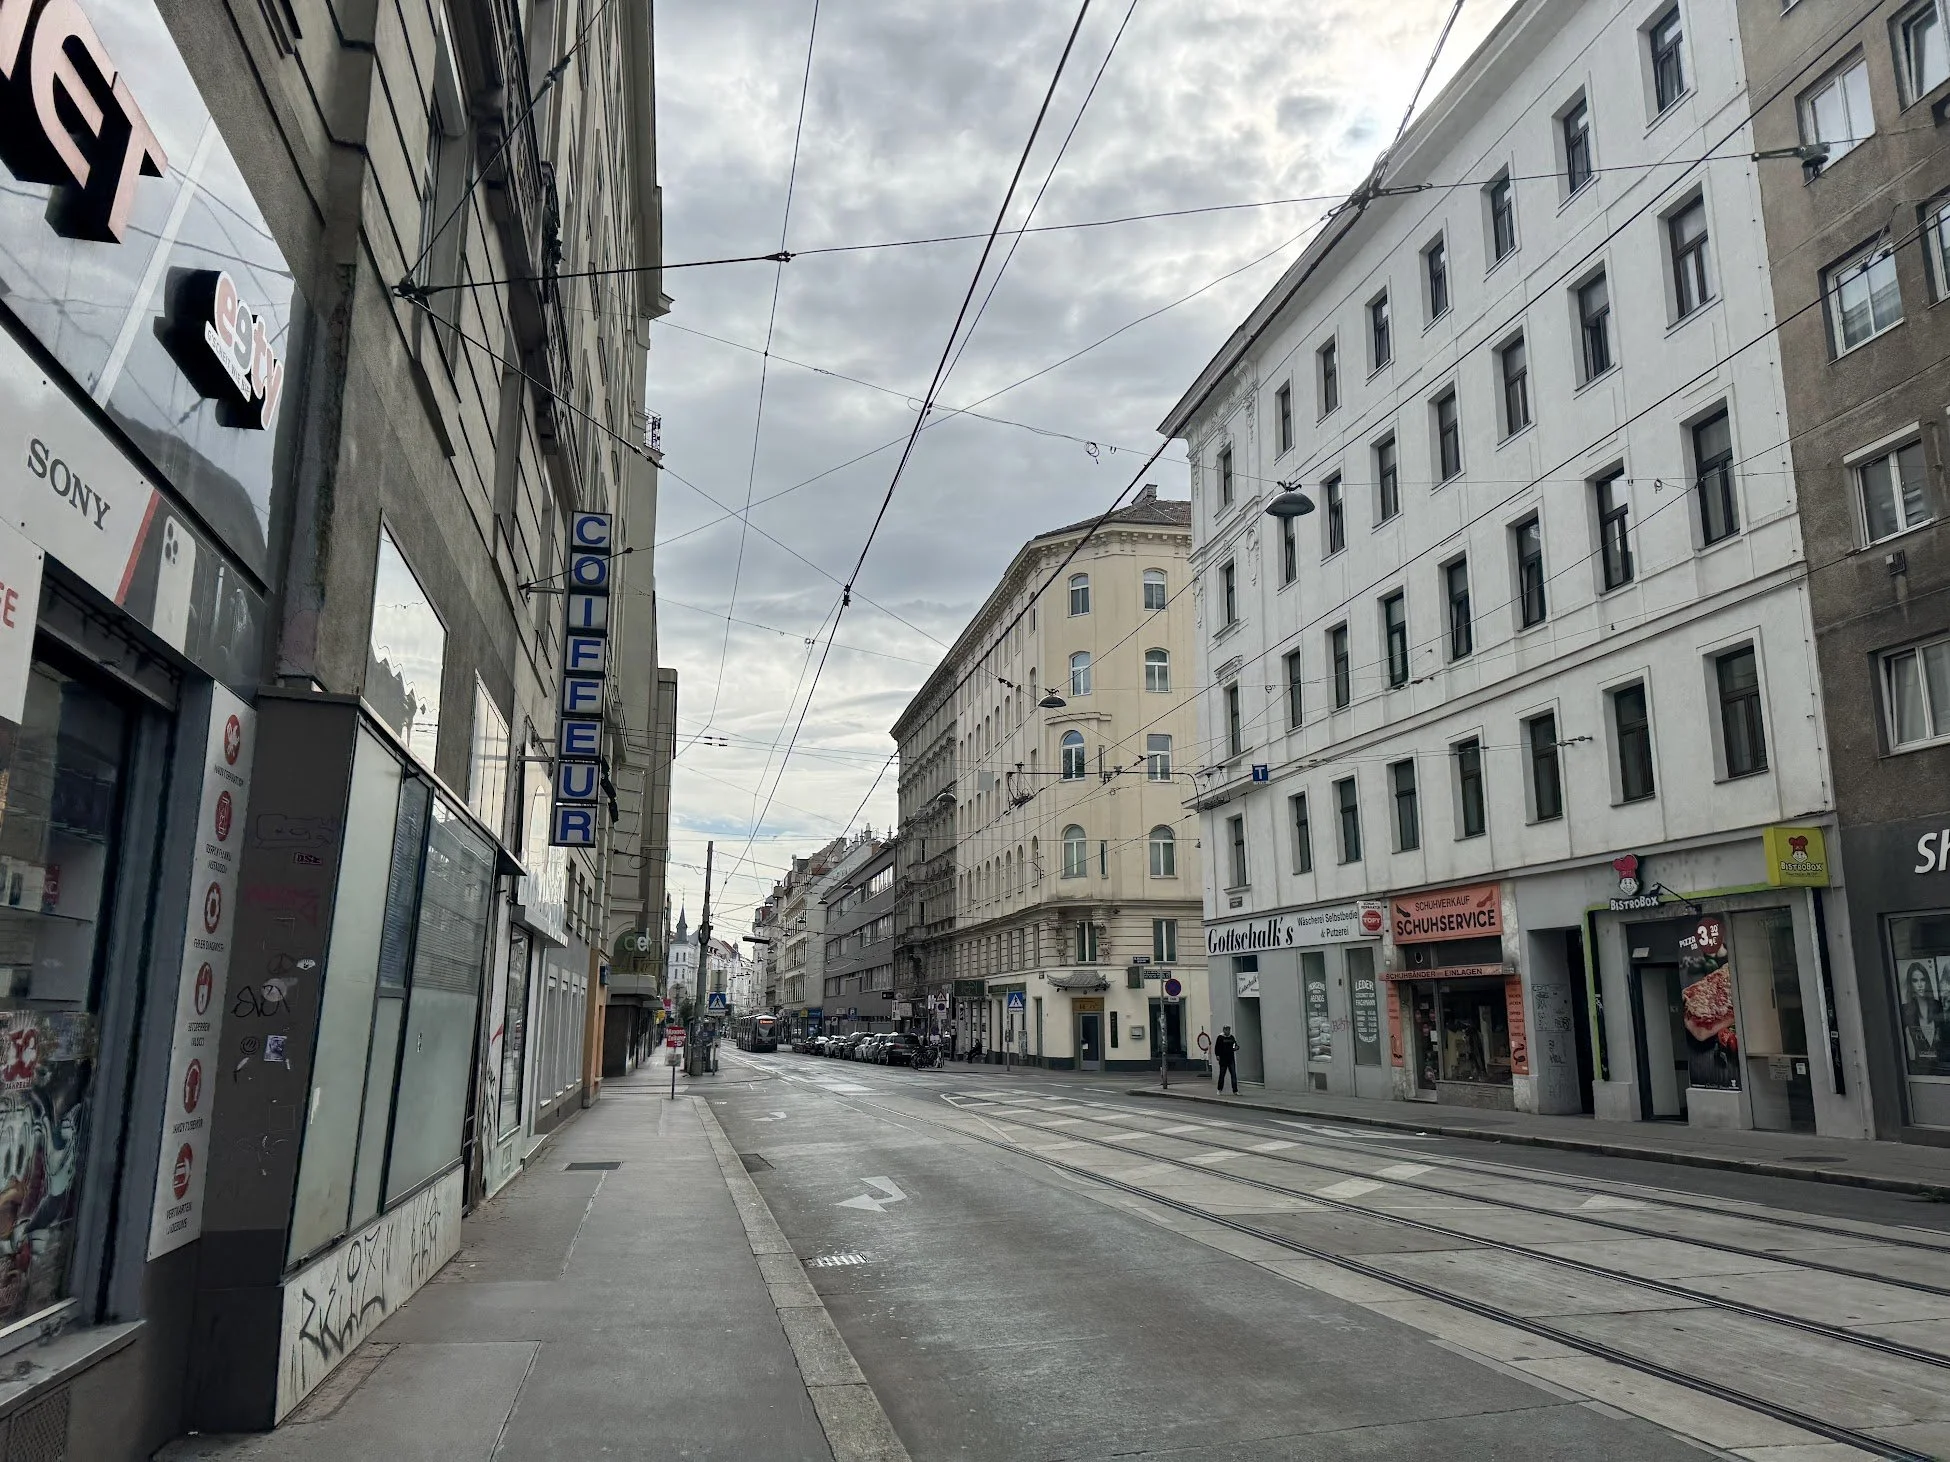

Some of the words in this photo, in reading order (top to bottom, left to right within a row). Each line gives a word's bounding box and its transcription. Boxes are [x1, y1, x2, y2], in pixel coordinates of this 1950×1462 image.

[28, 437, 111, 531] SONY
[559, 515, 607, 843] COIFFEUR
[1415, 895, 1470, 912] SCHUHVERKAUF
[1297, 913, 1325, 926] Wäscherei
[1396, 908, 1496, 936] SCHUHSERVICE
[1327, 925, 1349, 938] Putzerei
[1679, 935, 1697, 948] PIZZA
[1385, 970, 1436, 980] SCHUHBÄNDER
[1444, 967, 1483, 977] EINLAGEN
[1355, 979, 1375, 991] LEDER
